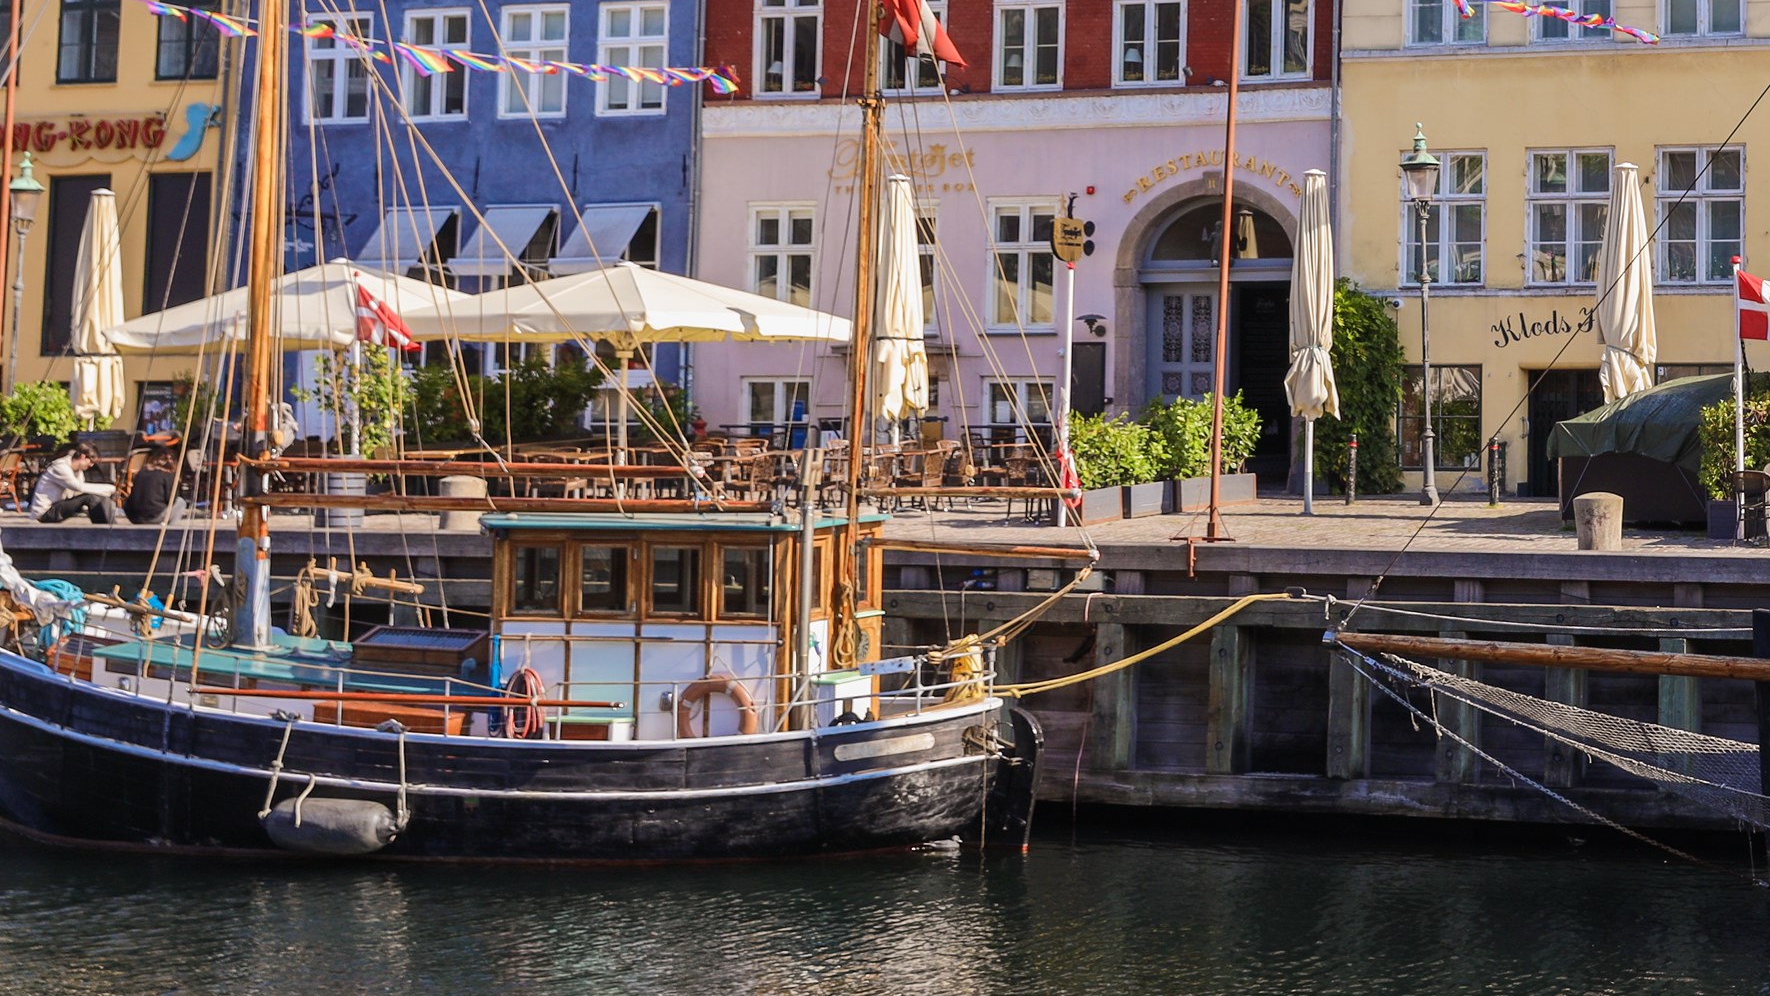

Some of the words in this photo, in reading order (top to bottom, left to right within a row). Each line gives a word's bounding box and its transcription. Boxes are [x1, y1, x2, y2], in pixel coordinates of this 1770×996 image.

[0, 117, 168, 152] NG-KONG
[1135, 150, 1291, 194] RESTAURANT
[1491, 310, 1572, 348] Klods
